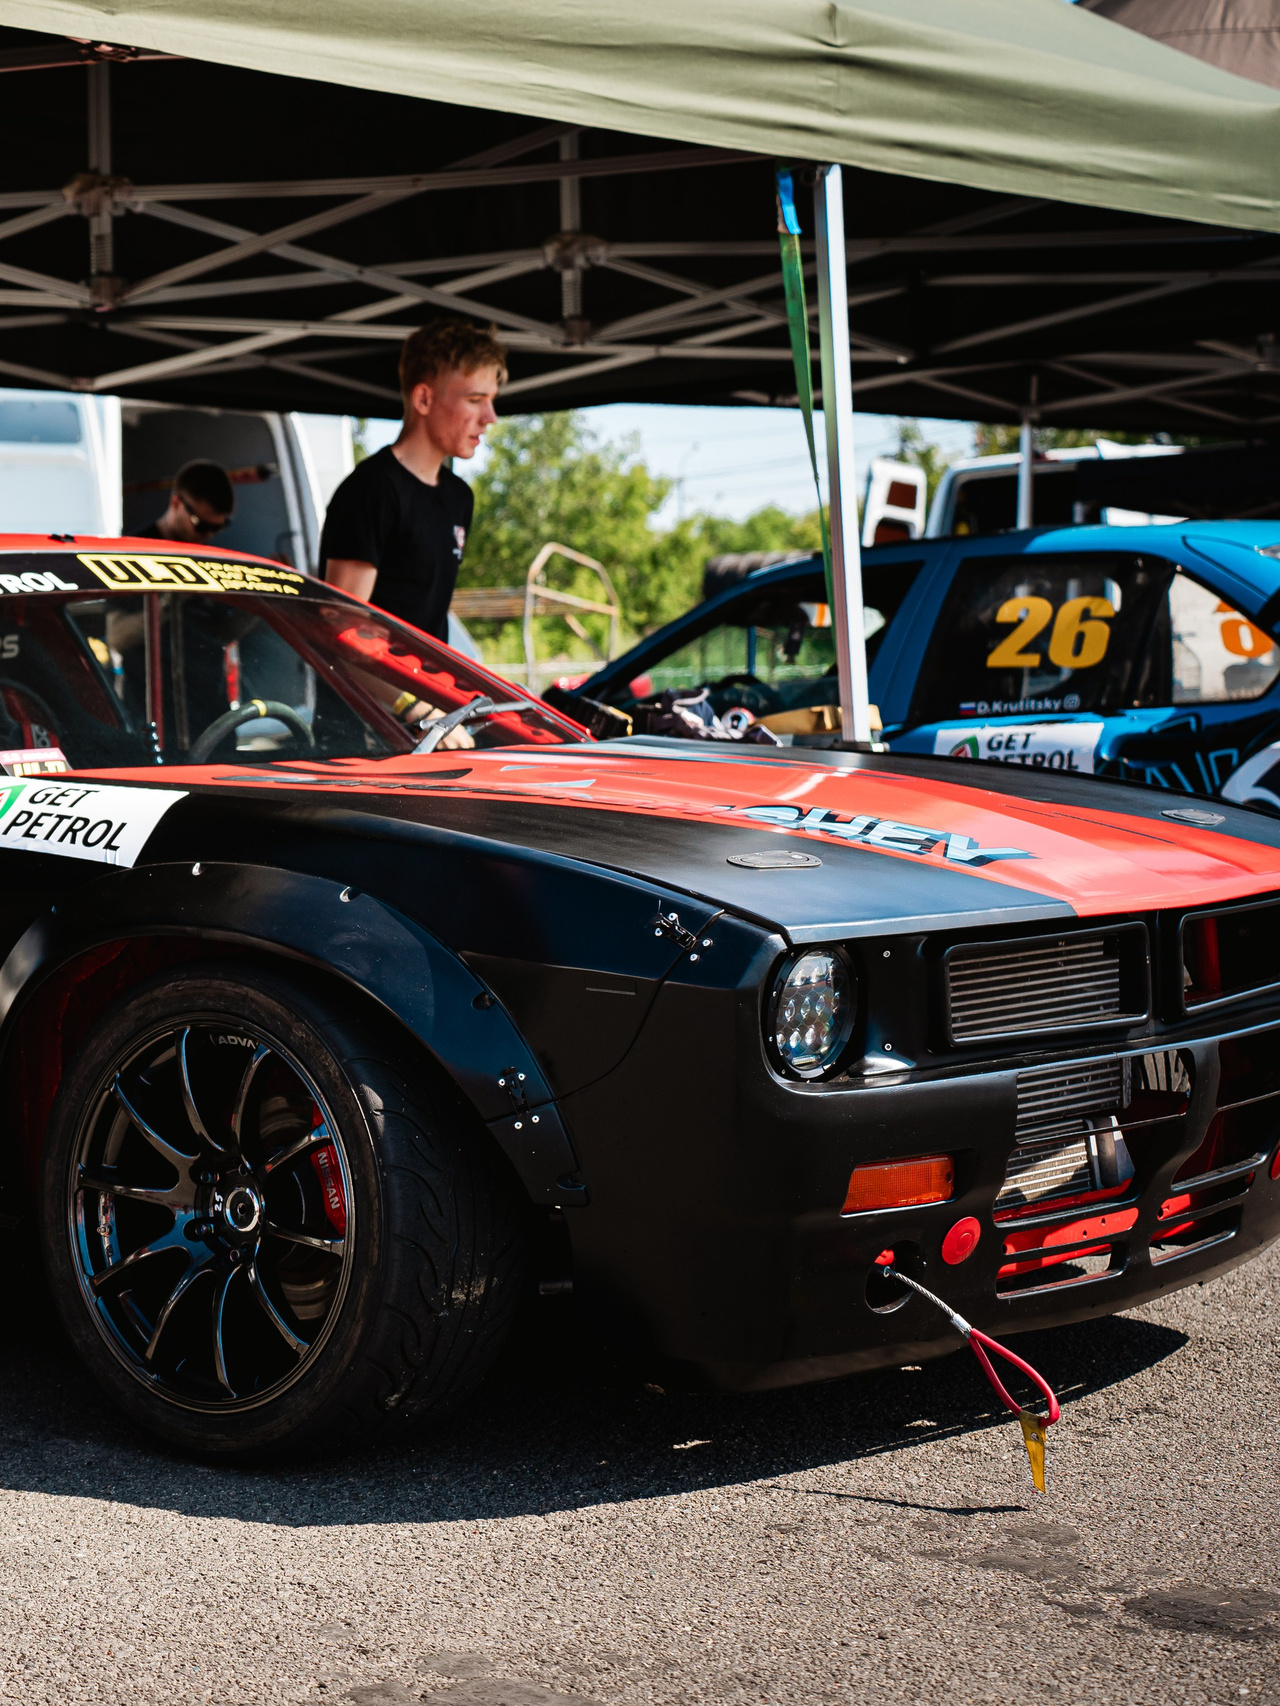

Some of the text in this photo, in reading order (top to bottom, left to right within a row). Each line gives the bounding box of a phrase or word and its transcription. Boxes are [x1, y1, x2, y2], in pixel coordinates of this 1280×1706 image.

[986, 595, 1116, 669] 26
[986, 732, 1037, 751] GET
[28, 786, 101, 808] GET
[1, 810, 128, 851] PETROL
[217, 1035, 259, 1050] ADVA
[317, 1151, 341, 1210] NISSAN
